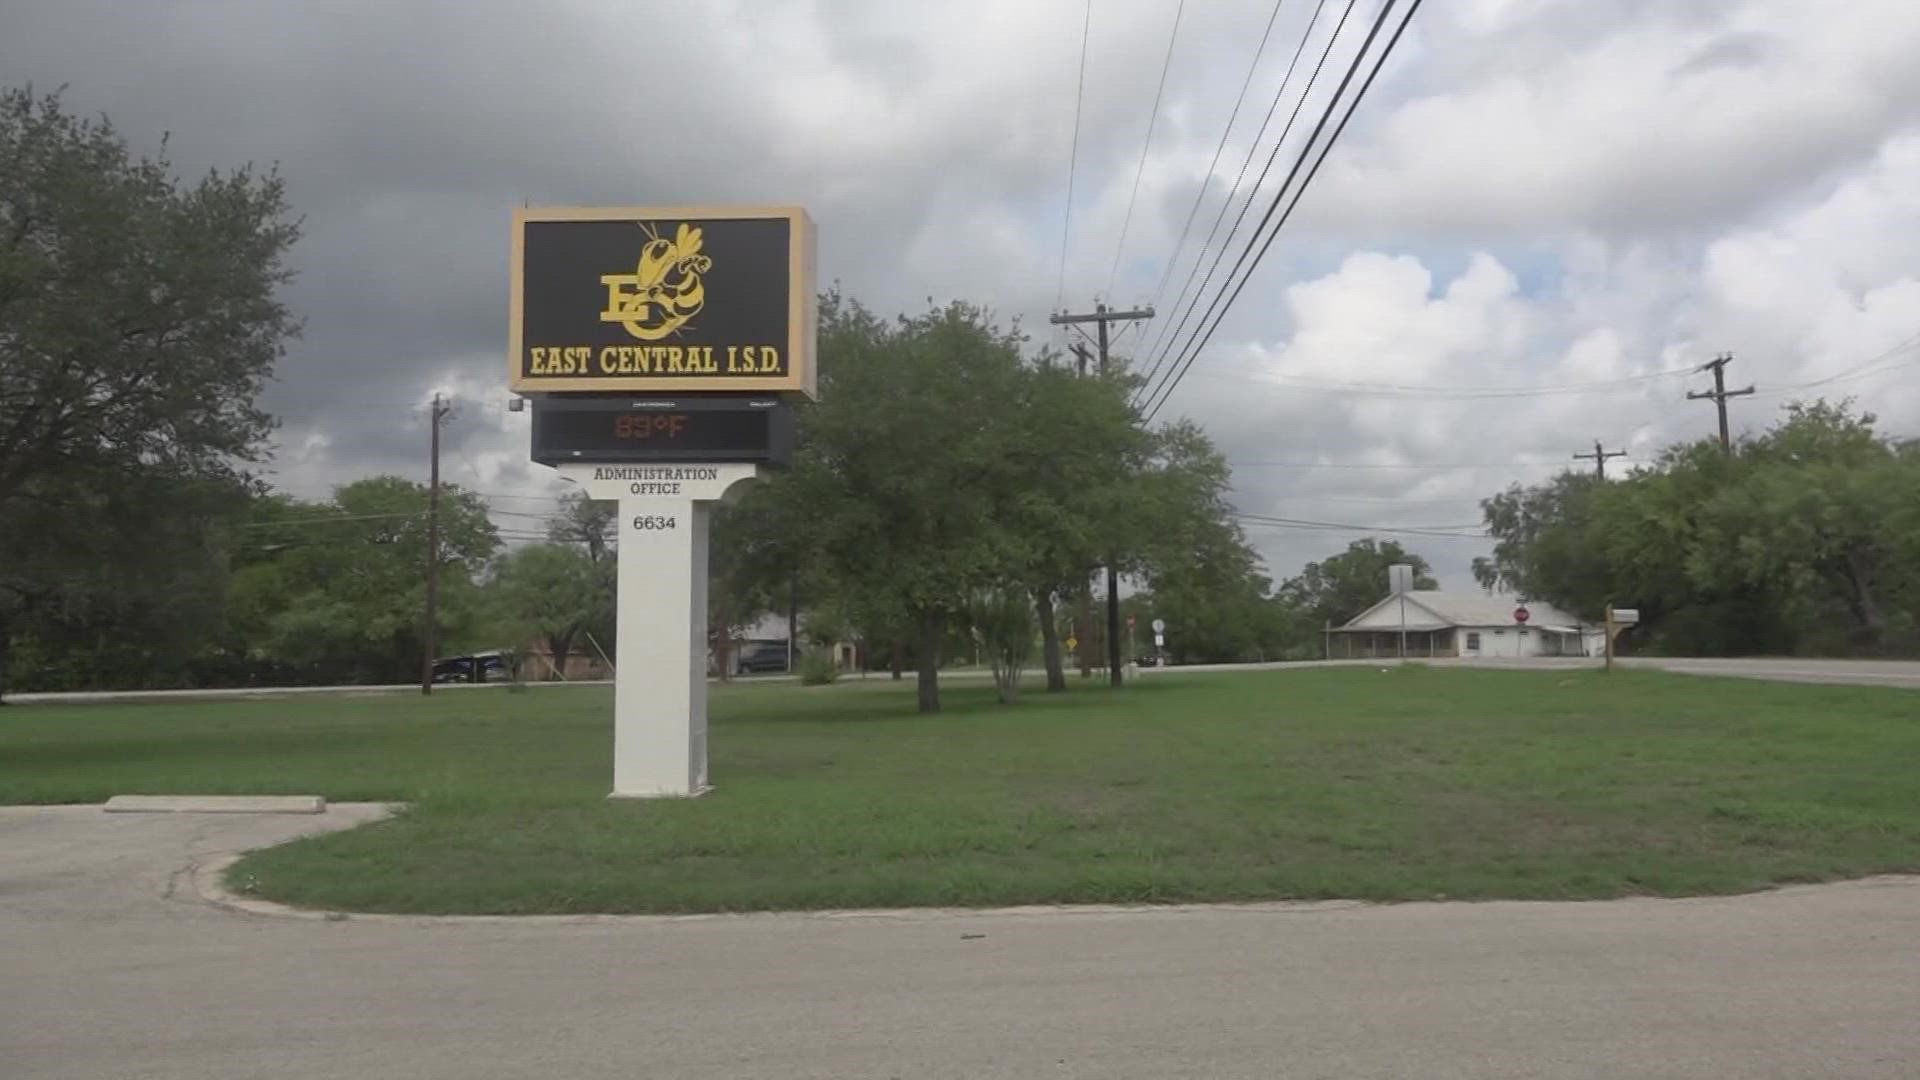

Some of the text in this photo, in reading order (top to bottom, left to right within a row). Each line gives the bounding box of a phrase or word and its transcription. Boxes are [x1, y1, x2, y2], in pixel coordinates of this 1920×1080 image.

[530, 345, 781, 375] EAST CENTRAL I.S.D.
[594, 467, 718, 481] ADMINISTRATION
[630, 482, 681, 495] OFFICE
[633, 515, 676, 530] 6634
